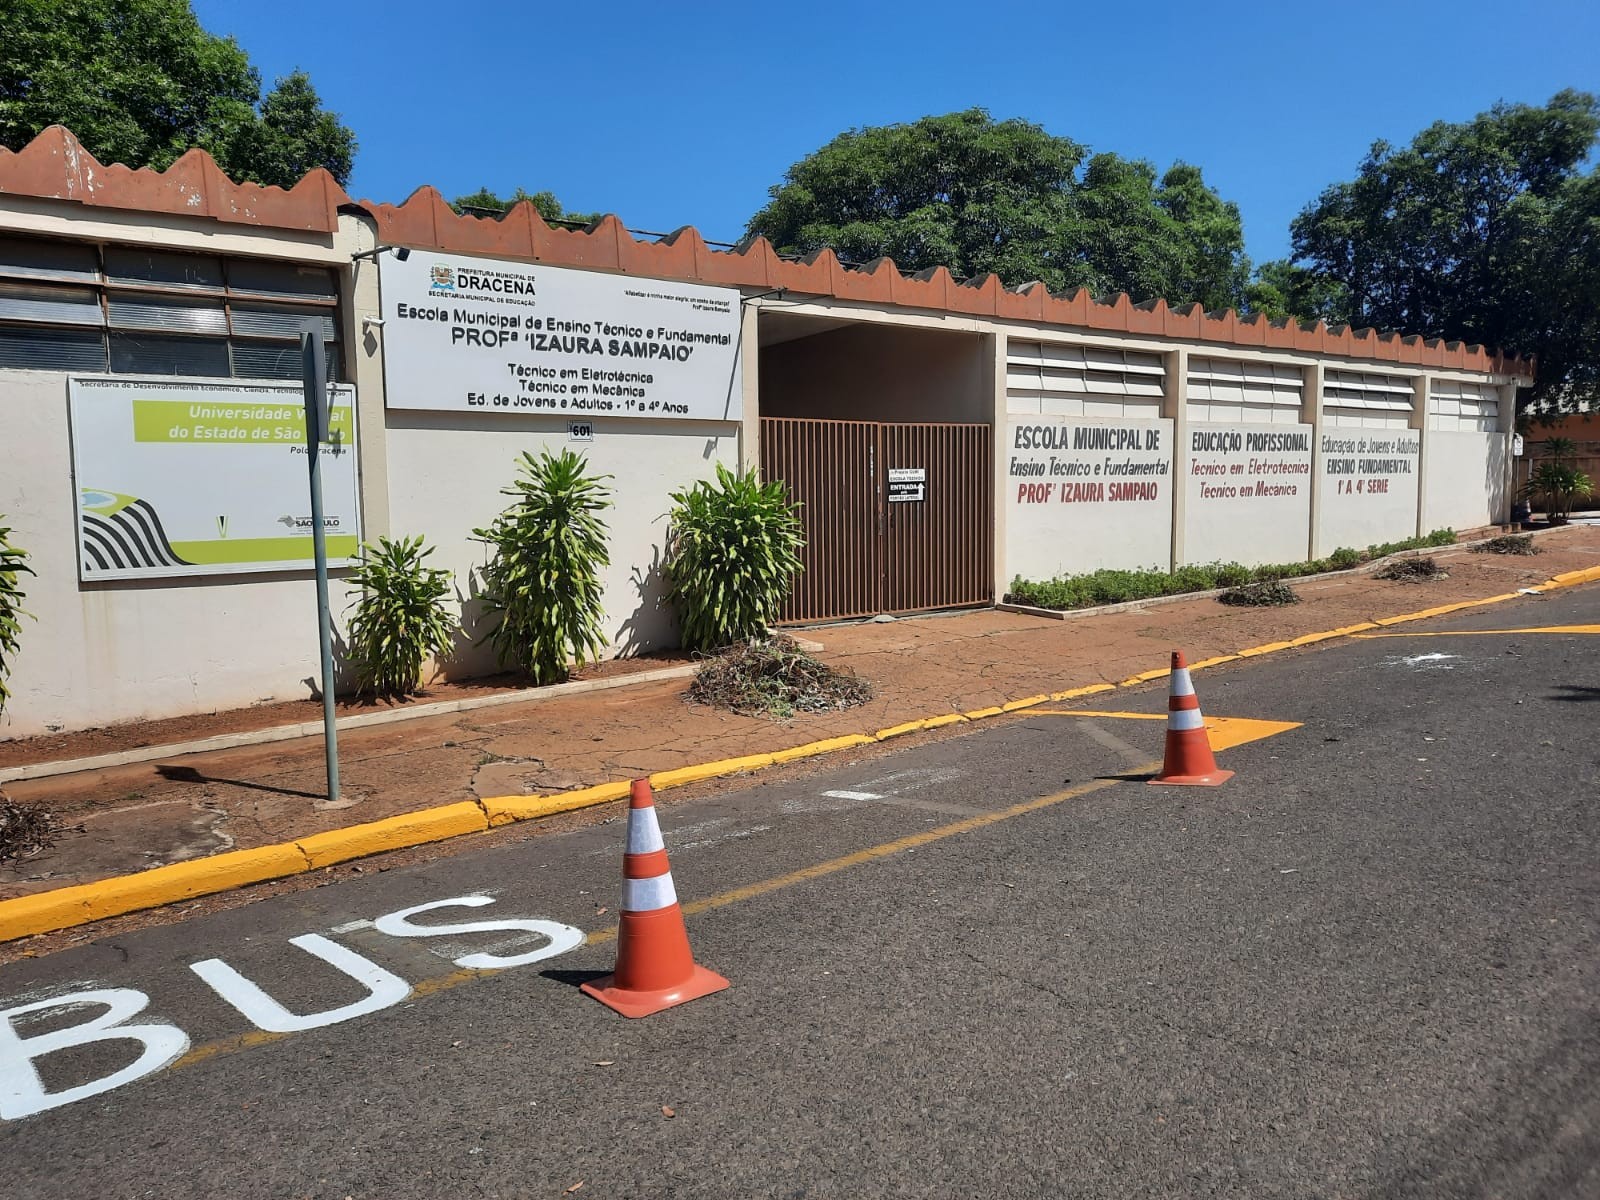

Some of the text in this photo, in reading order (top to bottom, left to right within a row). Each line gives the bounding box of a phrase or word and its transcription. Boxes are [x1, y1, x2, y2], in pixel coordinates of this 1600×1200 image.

[457, 267, 495, 277] PREFEITURA
[495, 272, 526, 281] MUNICIPAL
[457, 274, 536, 296] DRACENA
[428, 290, 465, 299] SECRETARIA
[465, 294, 496, 303] MUNICIPAL
[505, 298, 536, 307] EDUCAÇÃO
[397, 302, 731, 346] Escola Municipal de Ensino Técnico e Fundamental
[451, 326, 518, 349] PROFª
[507, 363, 653, 384] Técnico em Eletrotécnica
[121, 381, 131, 389] de
[519, 379, 646, 398] Técnico em Mecânica
[189, 404, 293, 421] Universidade
[467, 392, 489, 406] Ed.
[493, 393, 509, 407] de
[513, 395, 557, 409] Jovens
[560, 399, 568, 409] e
[570, 397, 613, 411] Adultos
[638, 402, 645, 412] a
[661, 402, 690, 414] Anos
[169, 424, 302, 440] do Estado de São
[573, 425, 590, 437] 601
[1014, 426, 1160, 450] ESCOLA MUNICIPAL DE
[1191, 429, 1309, 455] EDUCAÇÃO PROFISSIONAL
[1321, 434, 1419, 455] Educação de Jovens e Adultos
[1009, 456, 1169, 477] Ensino Técnico e Fundamental
[1229, 462, 1244, 475] em
[1326, 459, 1412, 475] ENSINO FUNDAMENTAL
[890, 483, 917, 491] ENTRADA
[1060, 482, 1105, 503] IZAURA
[1108, 481, 1158, 502] SAMPAIO
[1239, 485, 1253, 497] em
[1345, 479, 1353, 495] A
[0, 895, 586, 1121] BUS
